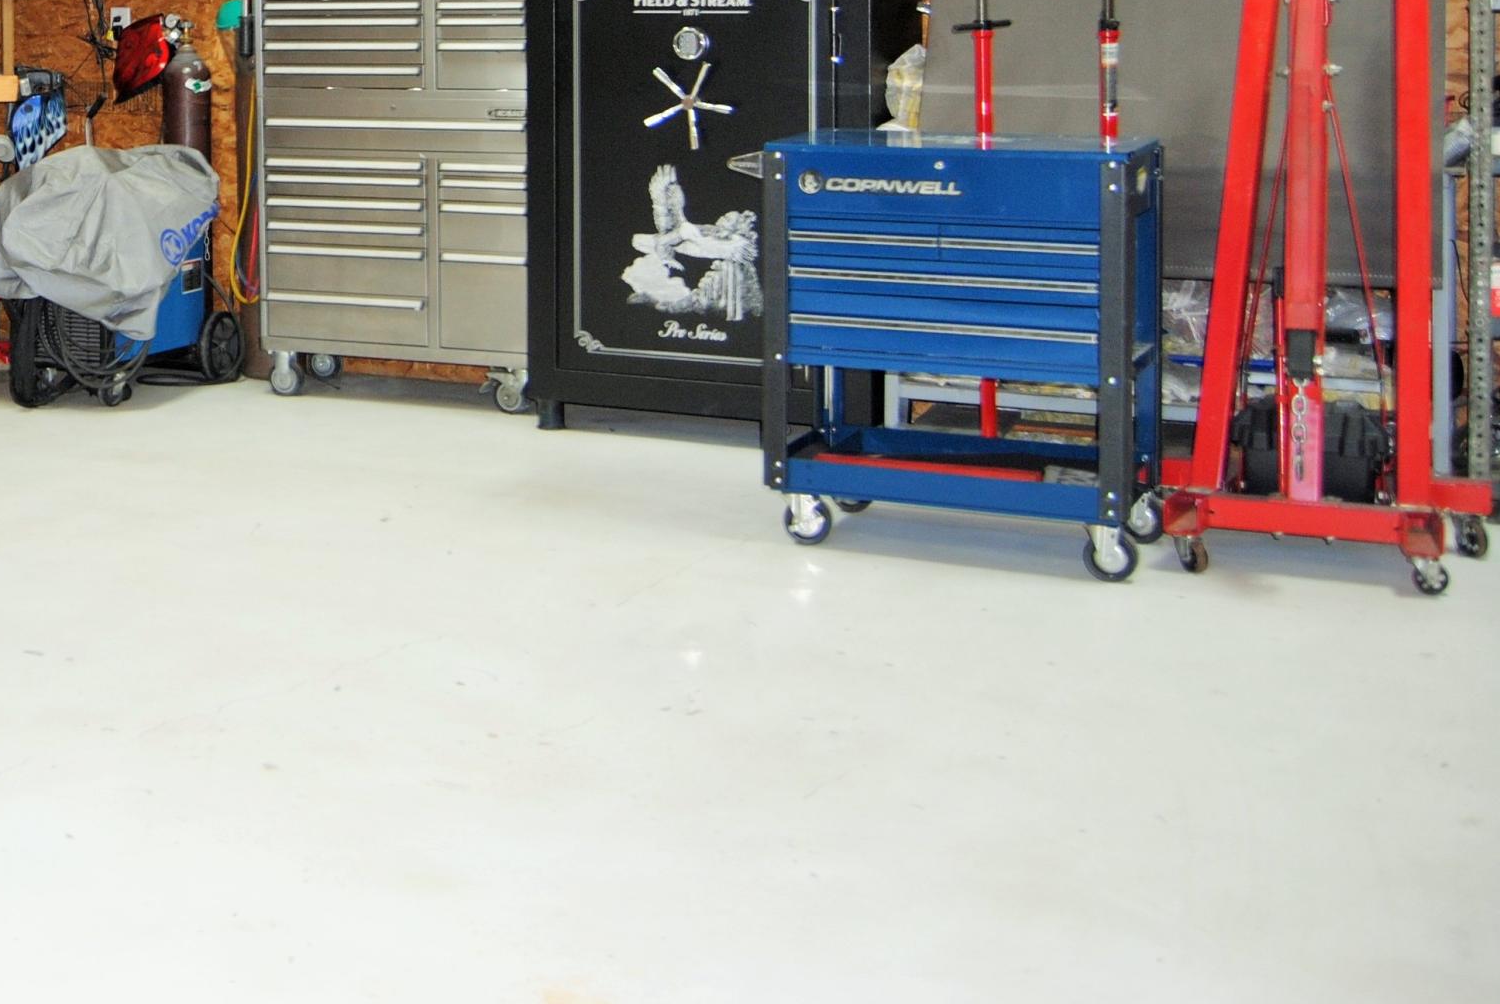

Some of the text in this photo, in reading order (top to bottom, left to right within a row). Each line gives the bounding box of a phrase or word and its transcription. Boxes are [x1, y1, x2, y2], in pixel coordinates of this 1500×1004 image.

[825, 178, 961, 196] CORNWELL
[657, 320, 727, 341] Pro Series
